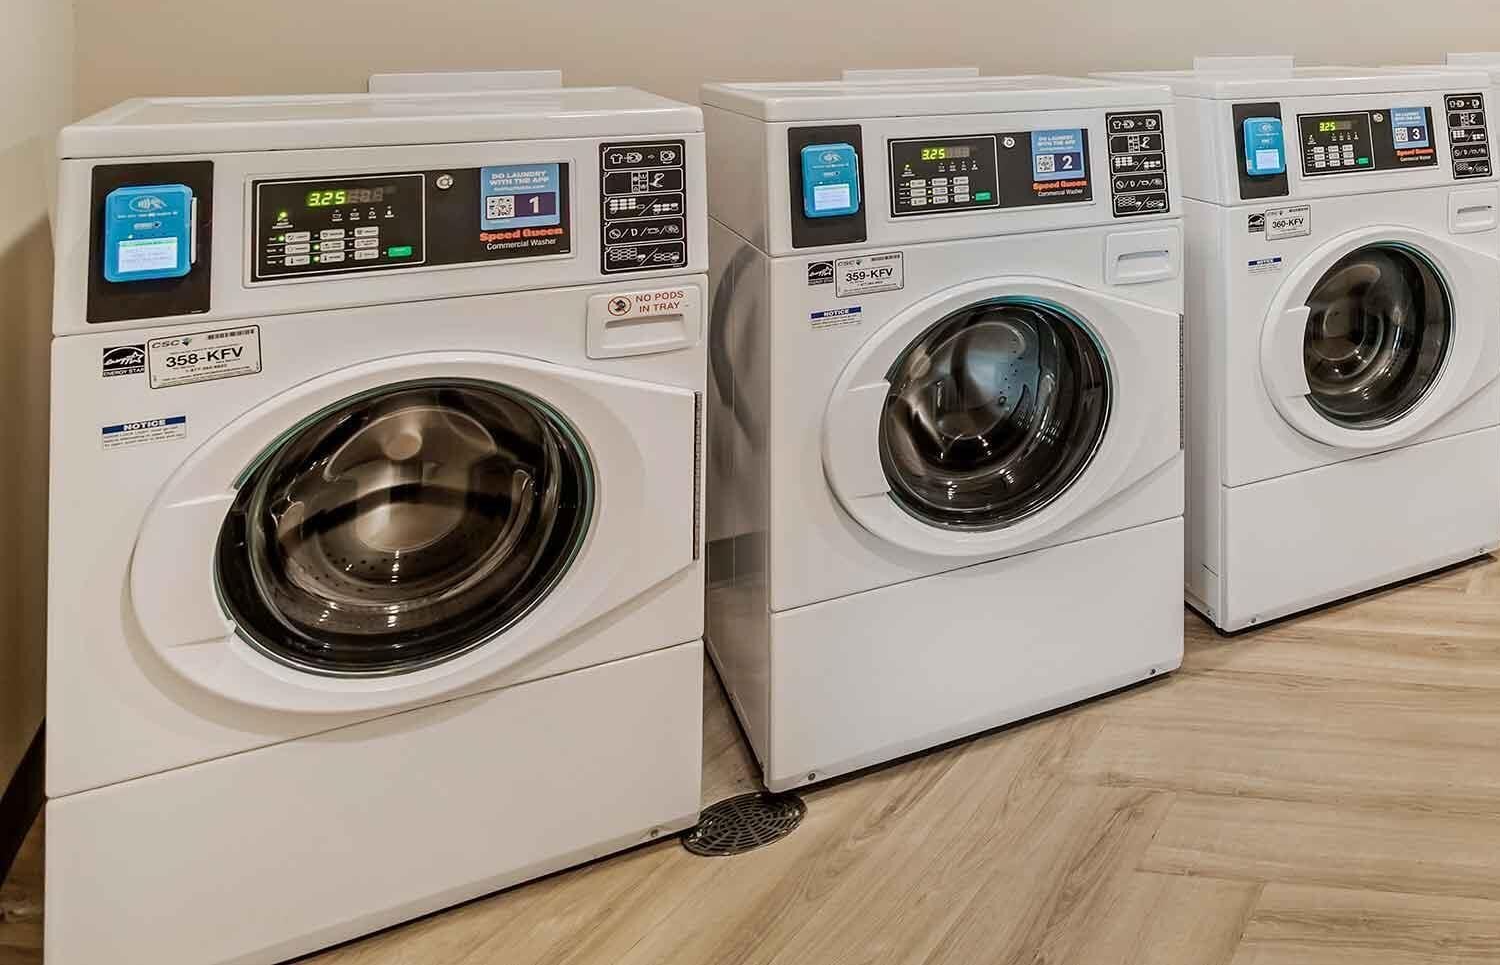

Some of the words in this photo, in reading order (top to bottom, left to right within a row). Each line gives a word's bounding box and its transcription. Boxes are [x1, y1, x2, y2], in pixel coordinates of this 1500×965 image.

[1413, 128, 1420, 139] 3
[1062, 156, 1072, 169] 2
[308, 191, 346, 207] 3.25
[529, 196, 540, 214] 1
[1272, 218, 1304, 228] 360-KFV
[480, 230, 520, 242] Speed
[522, 228, 563, 237] Queen
[486, 240, 529, 251] Commercial
[530, 238, 556, 246] Washer
[846, 268, 893, 282] 359-KFV
[636, 294, 651, 302] NO
[655, 291, 684, 300] PODS
[654, 301, 680, 312] TRAY
[152, 339, 180, 348] CSC
[166, 346, 243, 368] 358-KFV
[104, 369, 127, 377] ENERGY
[123, 419, 166, 431] NOTICE
